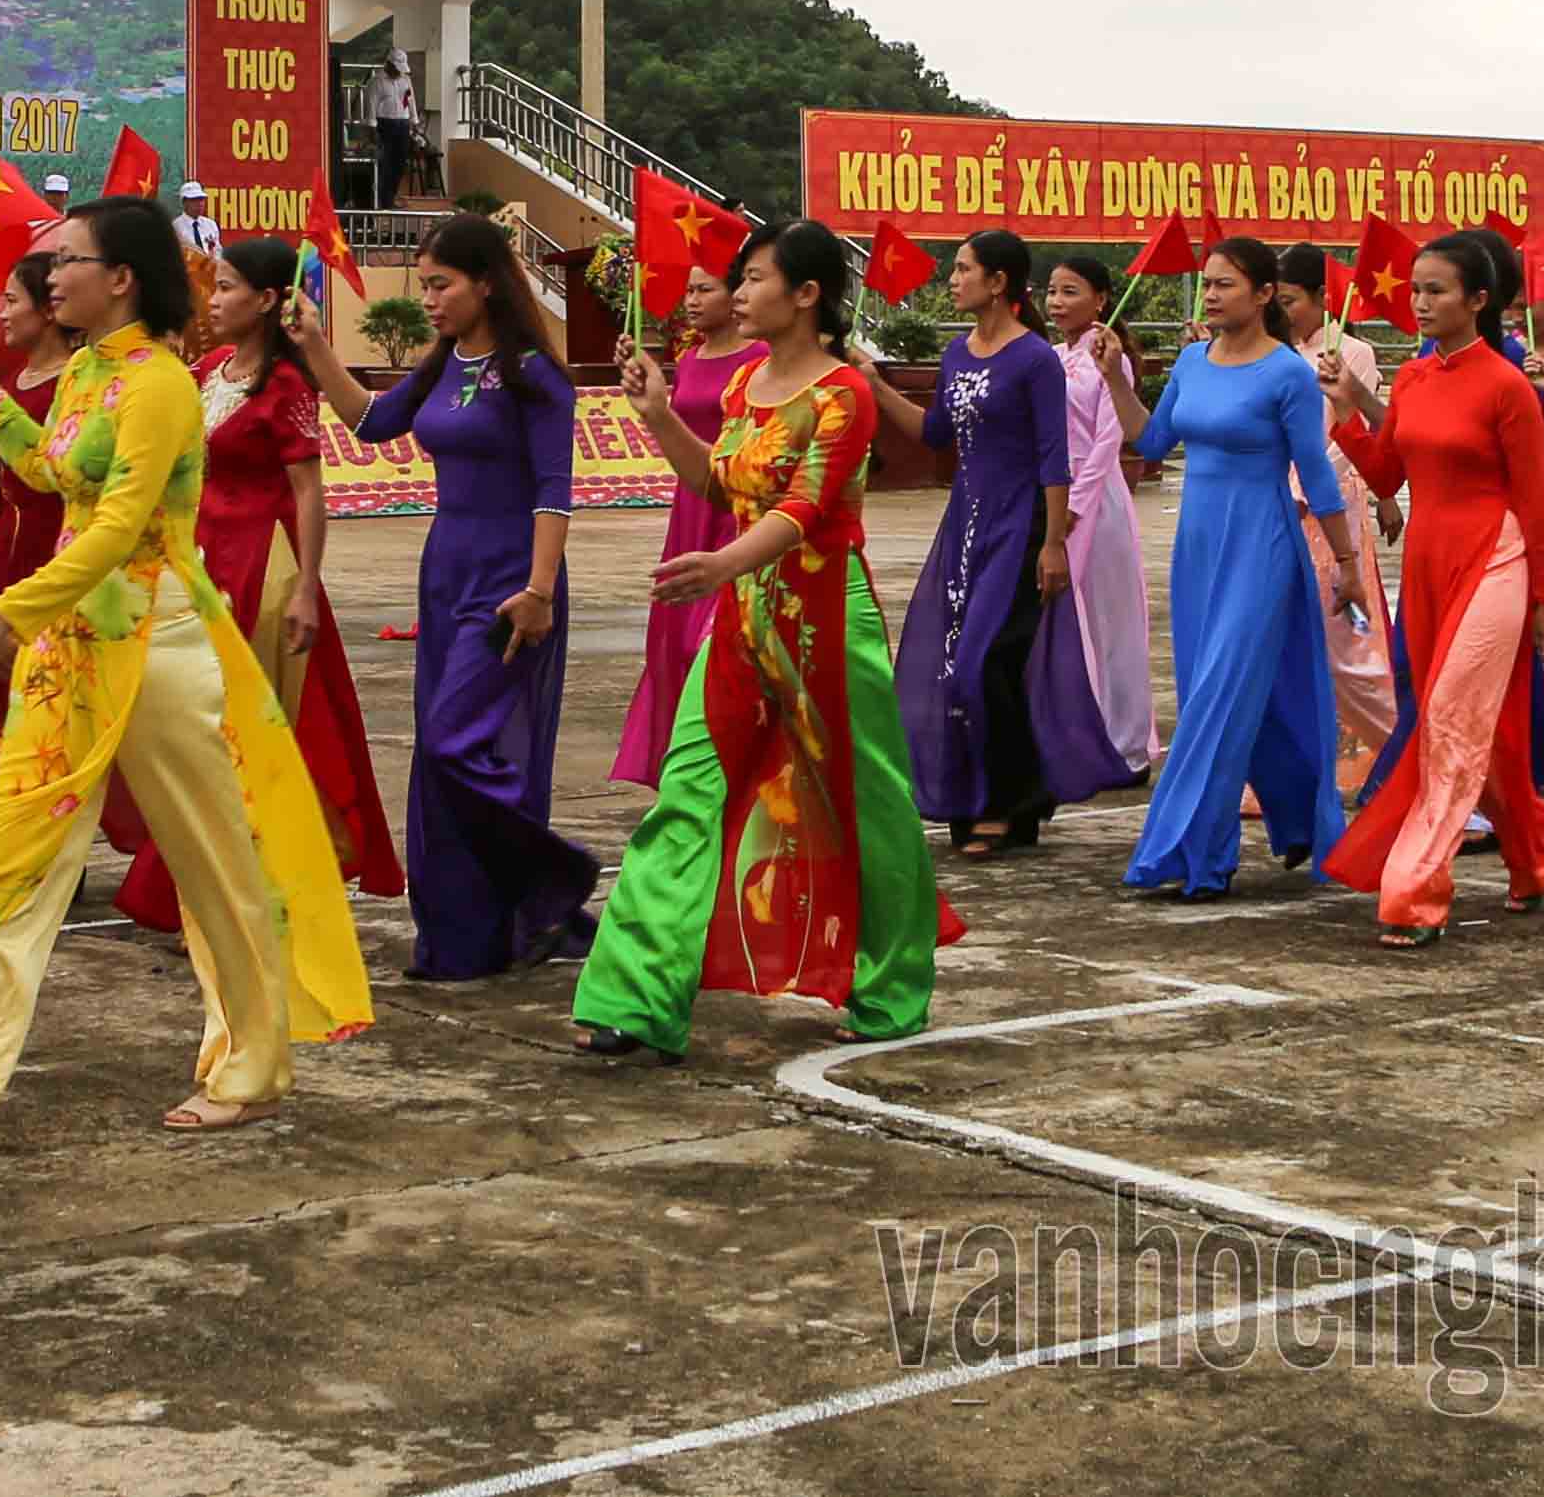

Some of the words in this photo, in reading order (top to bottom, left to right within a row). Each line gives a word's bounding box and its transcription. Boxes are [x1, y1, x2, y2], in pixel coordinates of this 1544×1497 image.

[222, 46, 296, 101] THỰC
[9, 96, 80, 153] 2017
[231, 118, 290, 162] CAO
[838, 128, 944, 214] KHỎE
[954, 133, 1007, 216] ĐỂ
[1016, 146, 1091, 217] XÂY
[1101, 155, 1202, 231] DỰNG
[1211, 151, 1259, 220] VÀ
[1267, 142, 1338, 222] BẢO
[1395, 148, 1435, 224] TỔ
[1444, 154, 1529, 232] QUỐC
